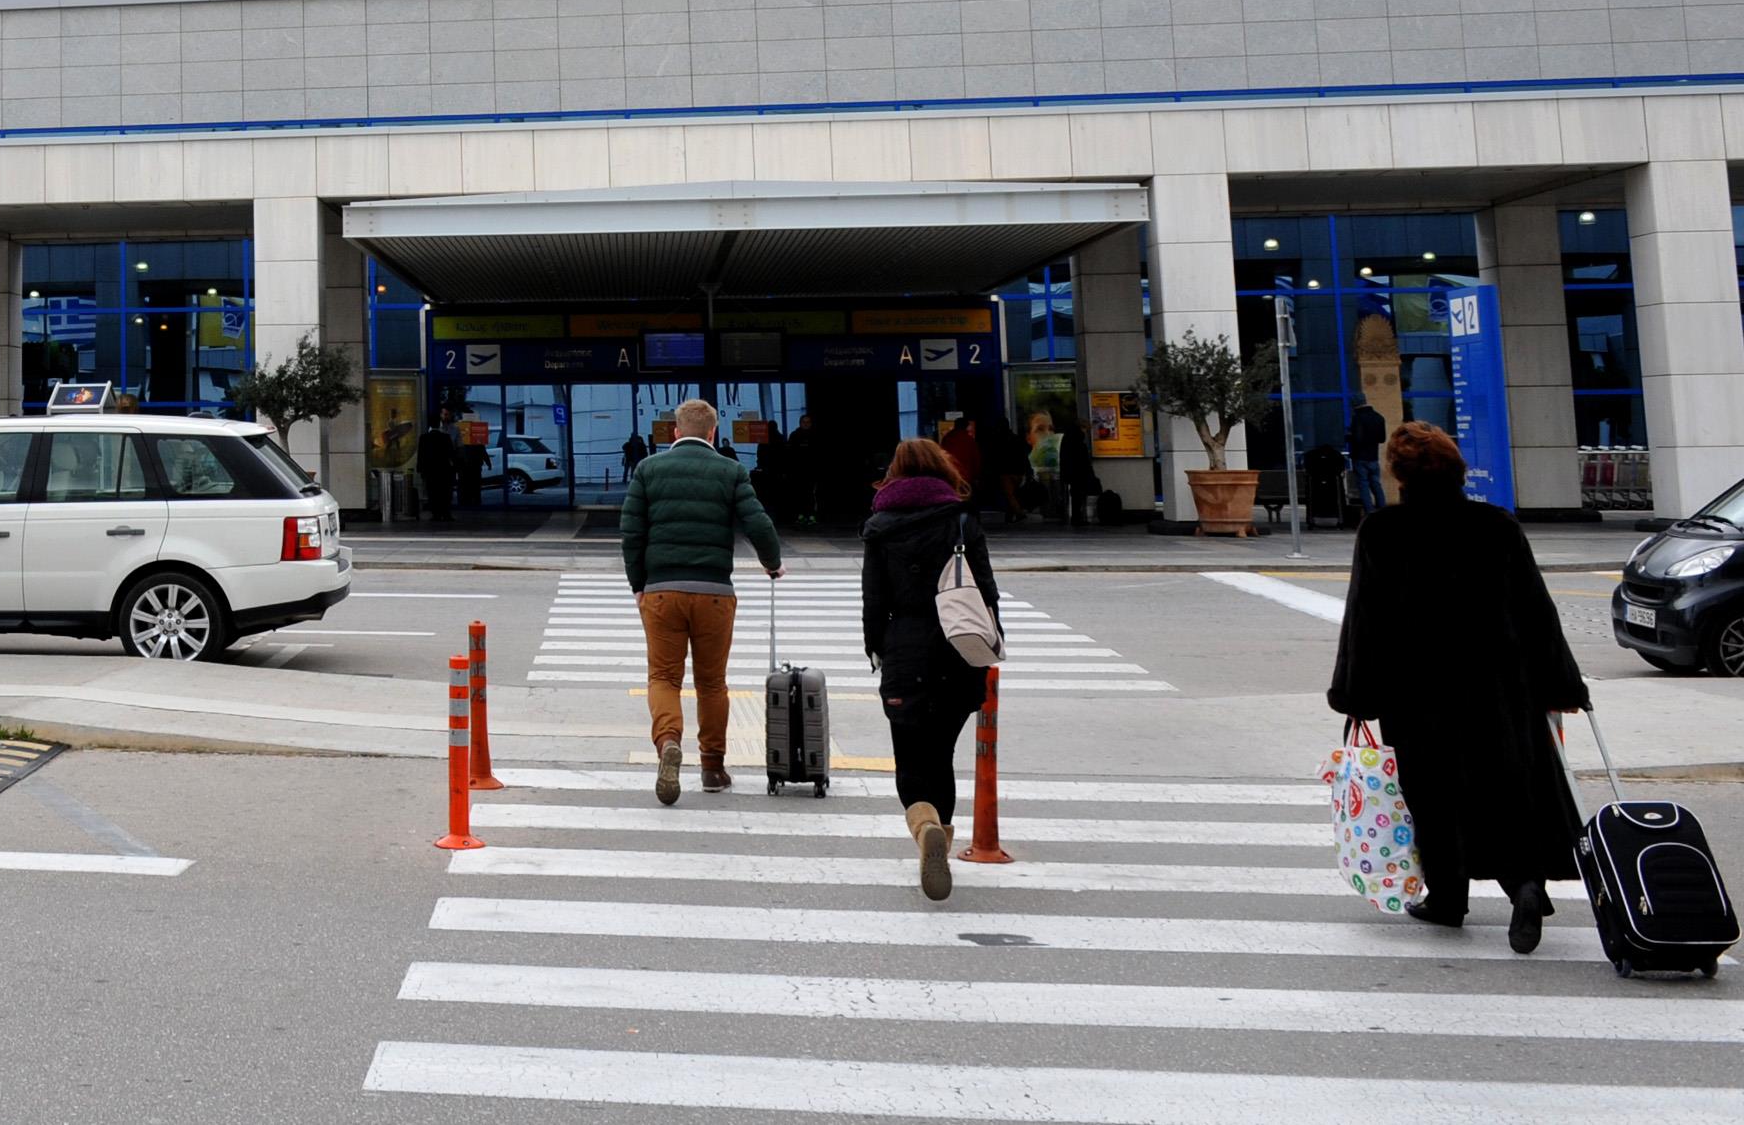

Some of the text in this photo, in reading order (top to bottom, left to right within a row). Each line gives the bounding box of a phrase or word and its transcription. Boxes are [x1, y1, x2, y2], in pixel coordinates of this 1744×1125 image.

[1468, 301, 1475, 329] 2
[446, 350, 456, 369] 2
[617, 348, 631, 368] A
[899, 345, 913, 364] A
[969, 344, 981, 364] 2
